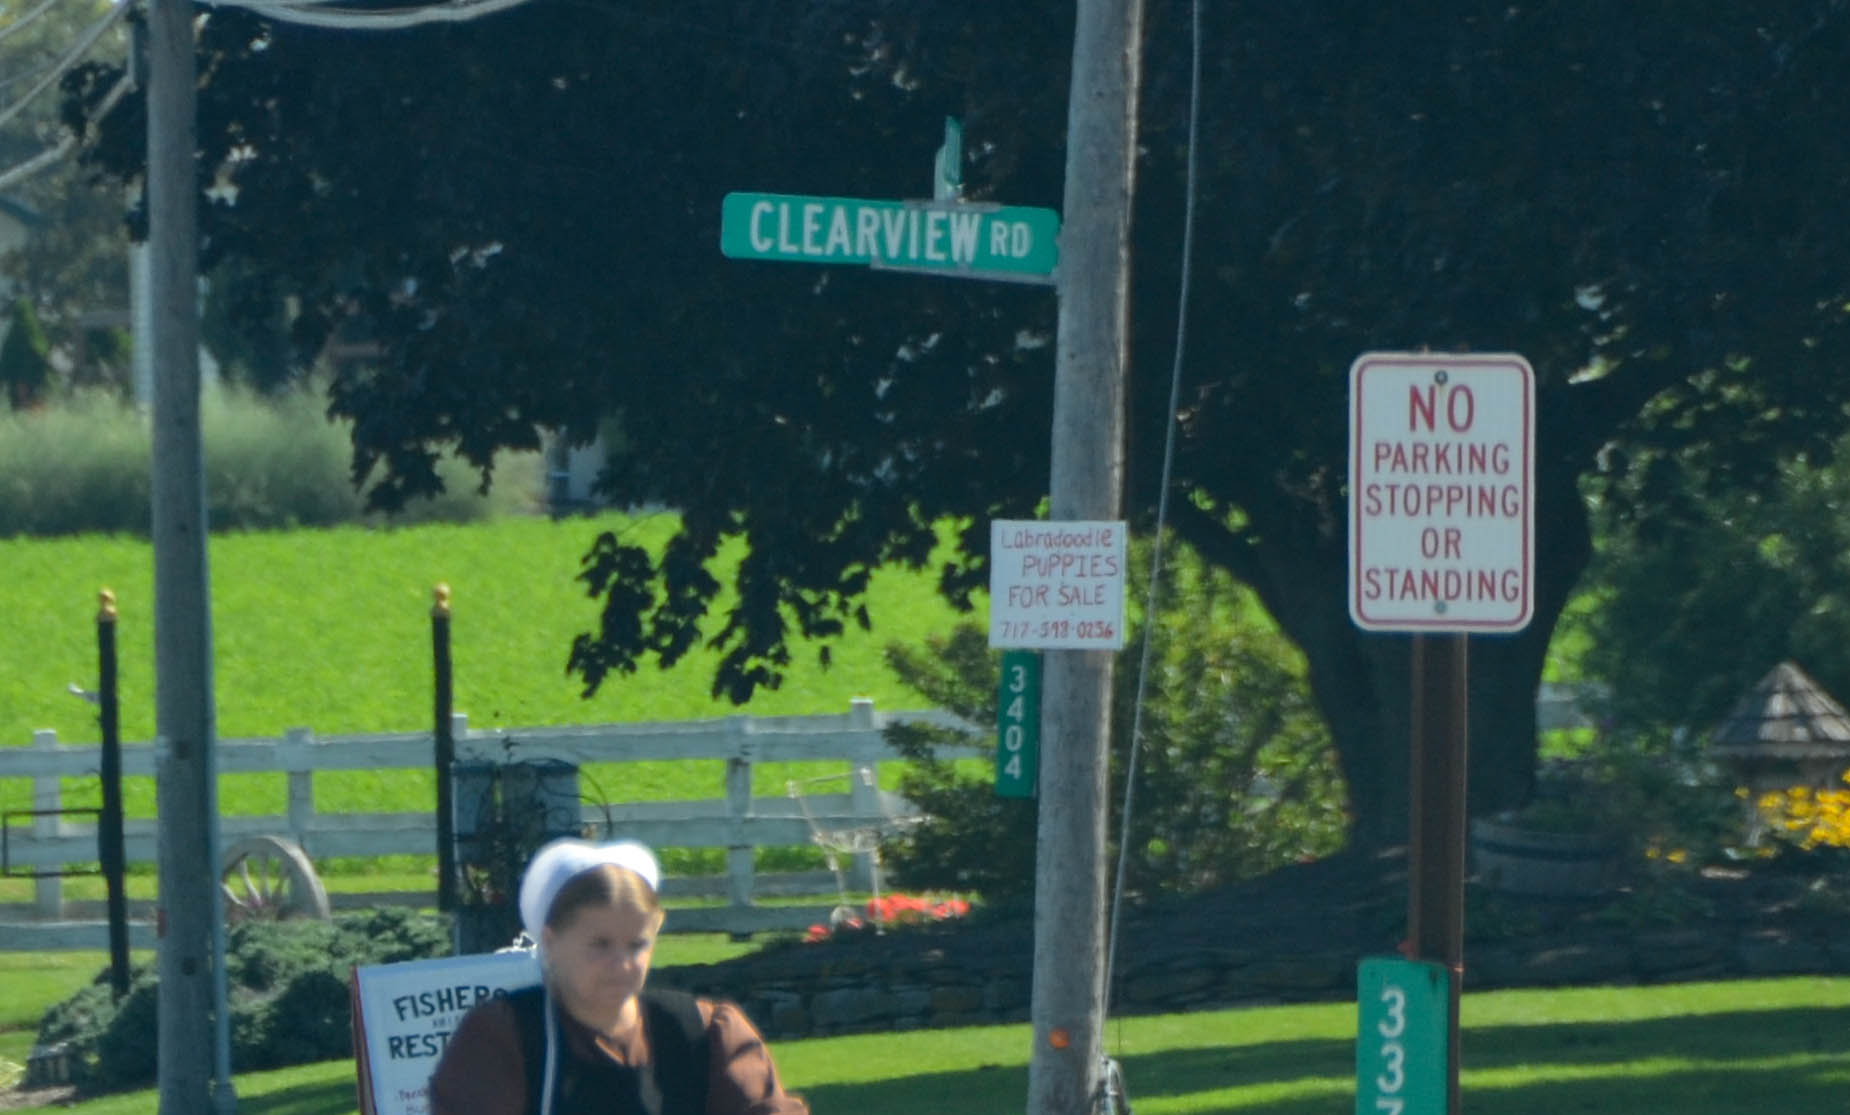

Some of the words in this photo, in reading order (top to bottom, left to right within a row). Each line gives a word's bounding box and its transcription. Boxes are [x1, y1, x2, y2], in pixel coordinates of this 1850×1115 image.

[751, 202, 982, 263] CLEARVIEW
[990, 222, 1030, 257] RD
[1409, 384, 1474, 433] NO
[1374, 442, 1509, 475] PARKING
[1365, 483, 1519, 517] STOPPING
[1002, 528, 1113, 549] Labradoodle
[1421, 527, 1462, 559] OR
[1022, 554, 1118, 578] PUPPIES
[1008, 584, 1049, 608] FOR
[1058, 584, 1106, 606] SALE
[1365, 568, 1519, 602] STANDING
[1004, 664, 1026, 780] 3404
